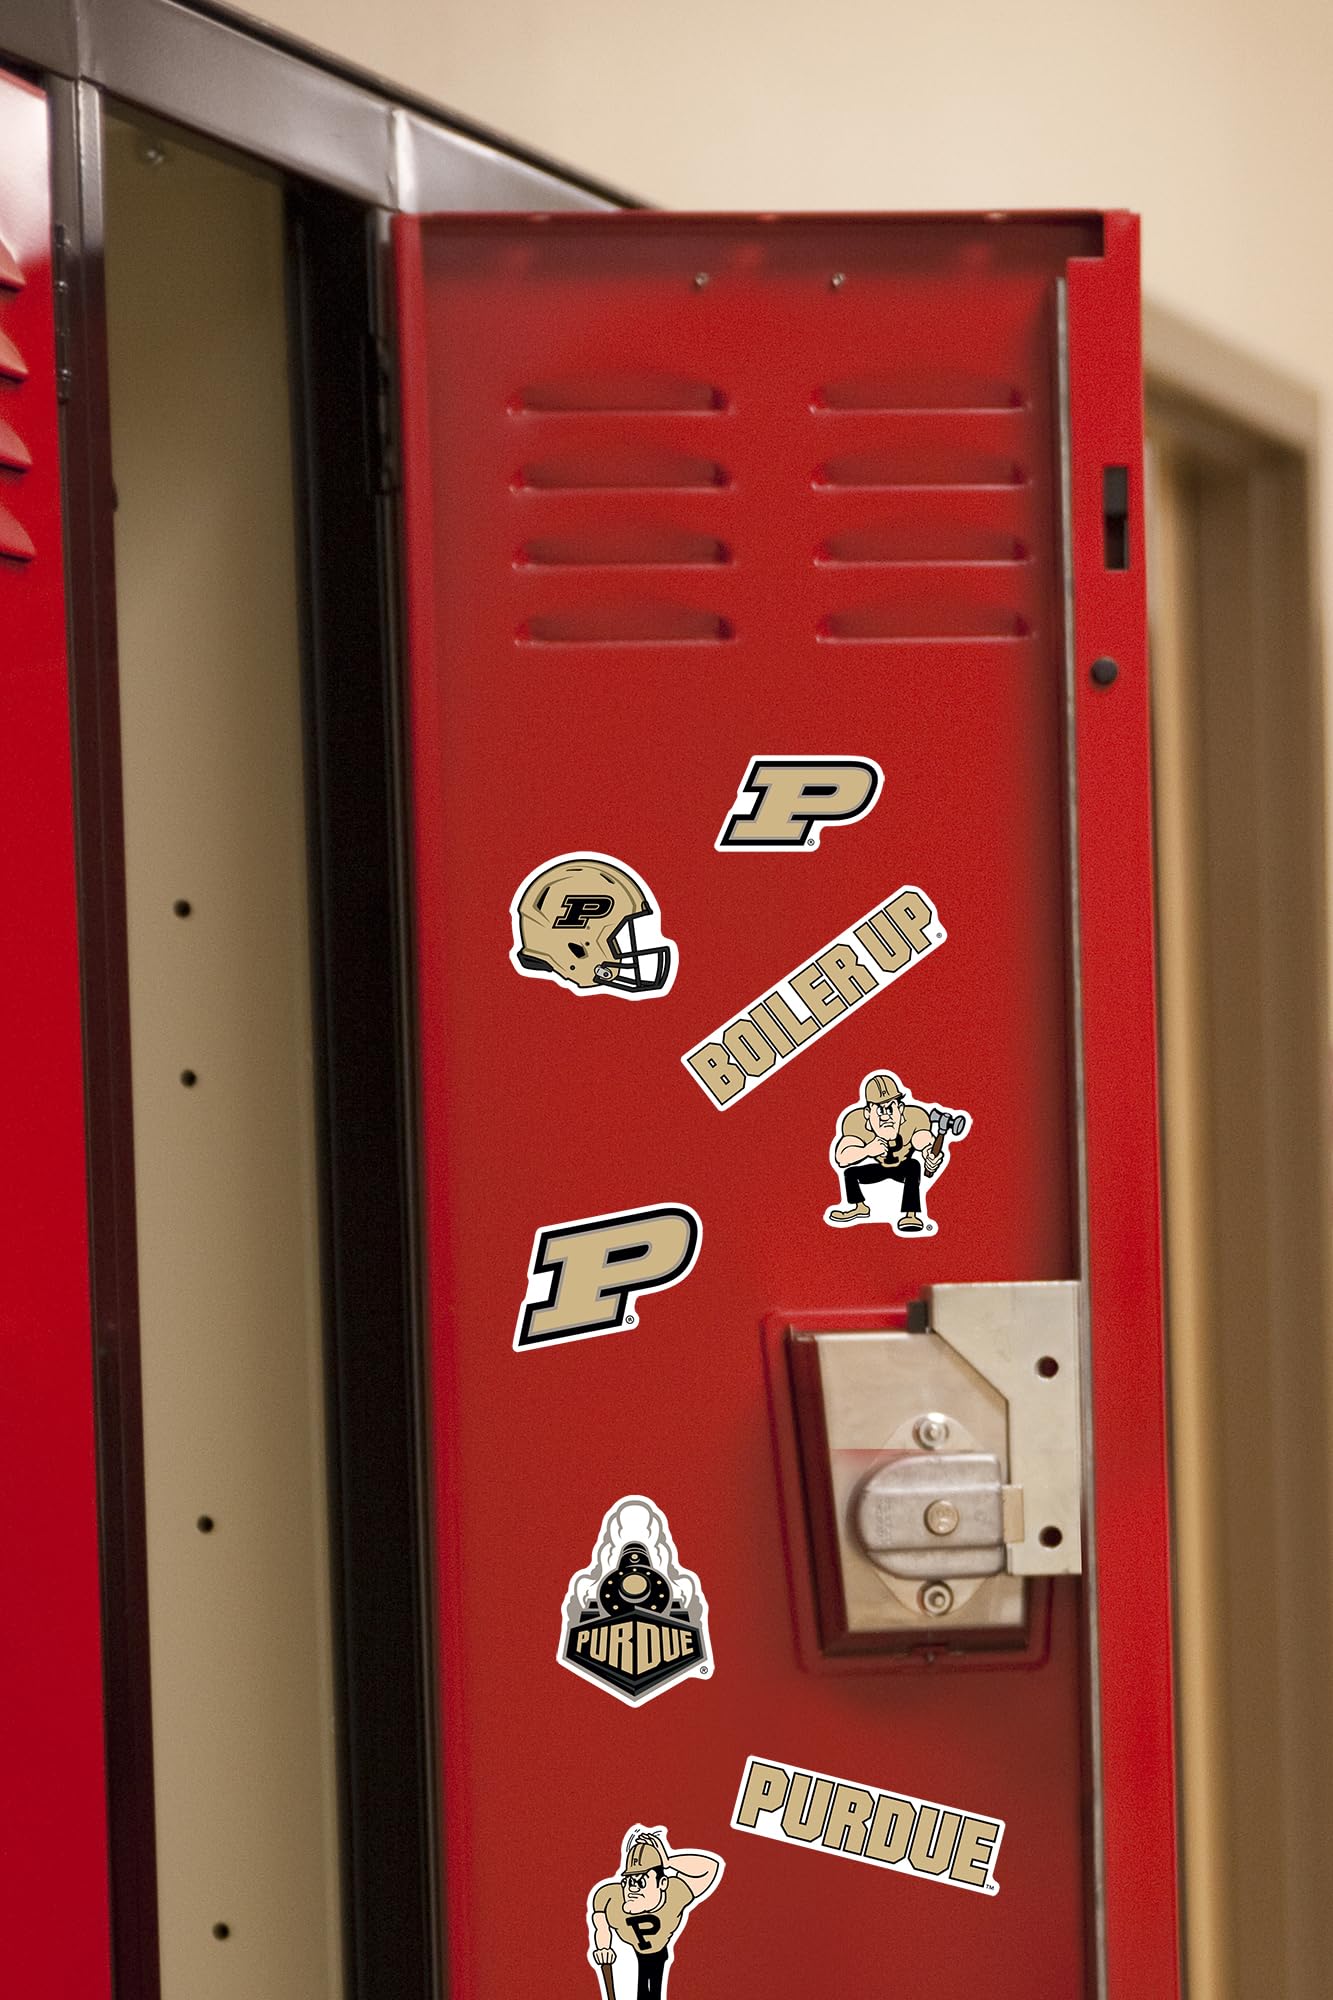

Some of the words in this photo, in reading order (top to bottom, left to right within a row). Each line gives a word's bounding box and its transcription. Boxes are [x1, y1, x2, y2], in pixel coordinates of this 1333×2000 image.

[720, 761, 878, 846] P
[552, 894, 615, 929] P
[687, 943, 879, 1105] BOILER
[853, 891, 932, 973] UP
[518, 1208, 698, 1346] P
[576, 1621, 694, 1675] PURDUE
[736, 1761, 1000, 1887] PURDUE
[625, 1914, 661, 1950] P
